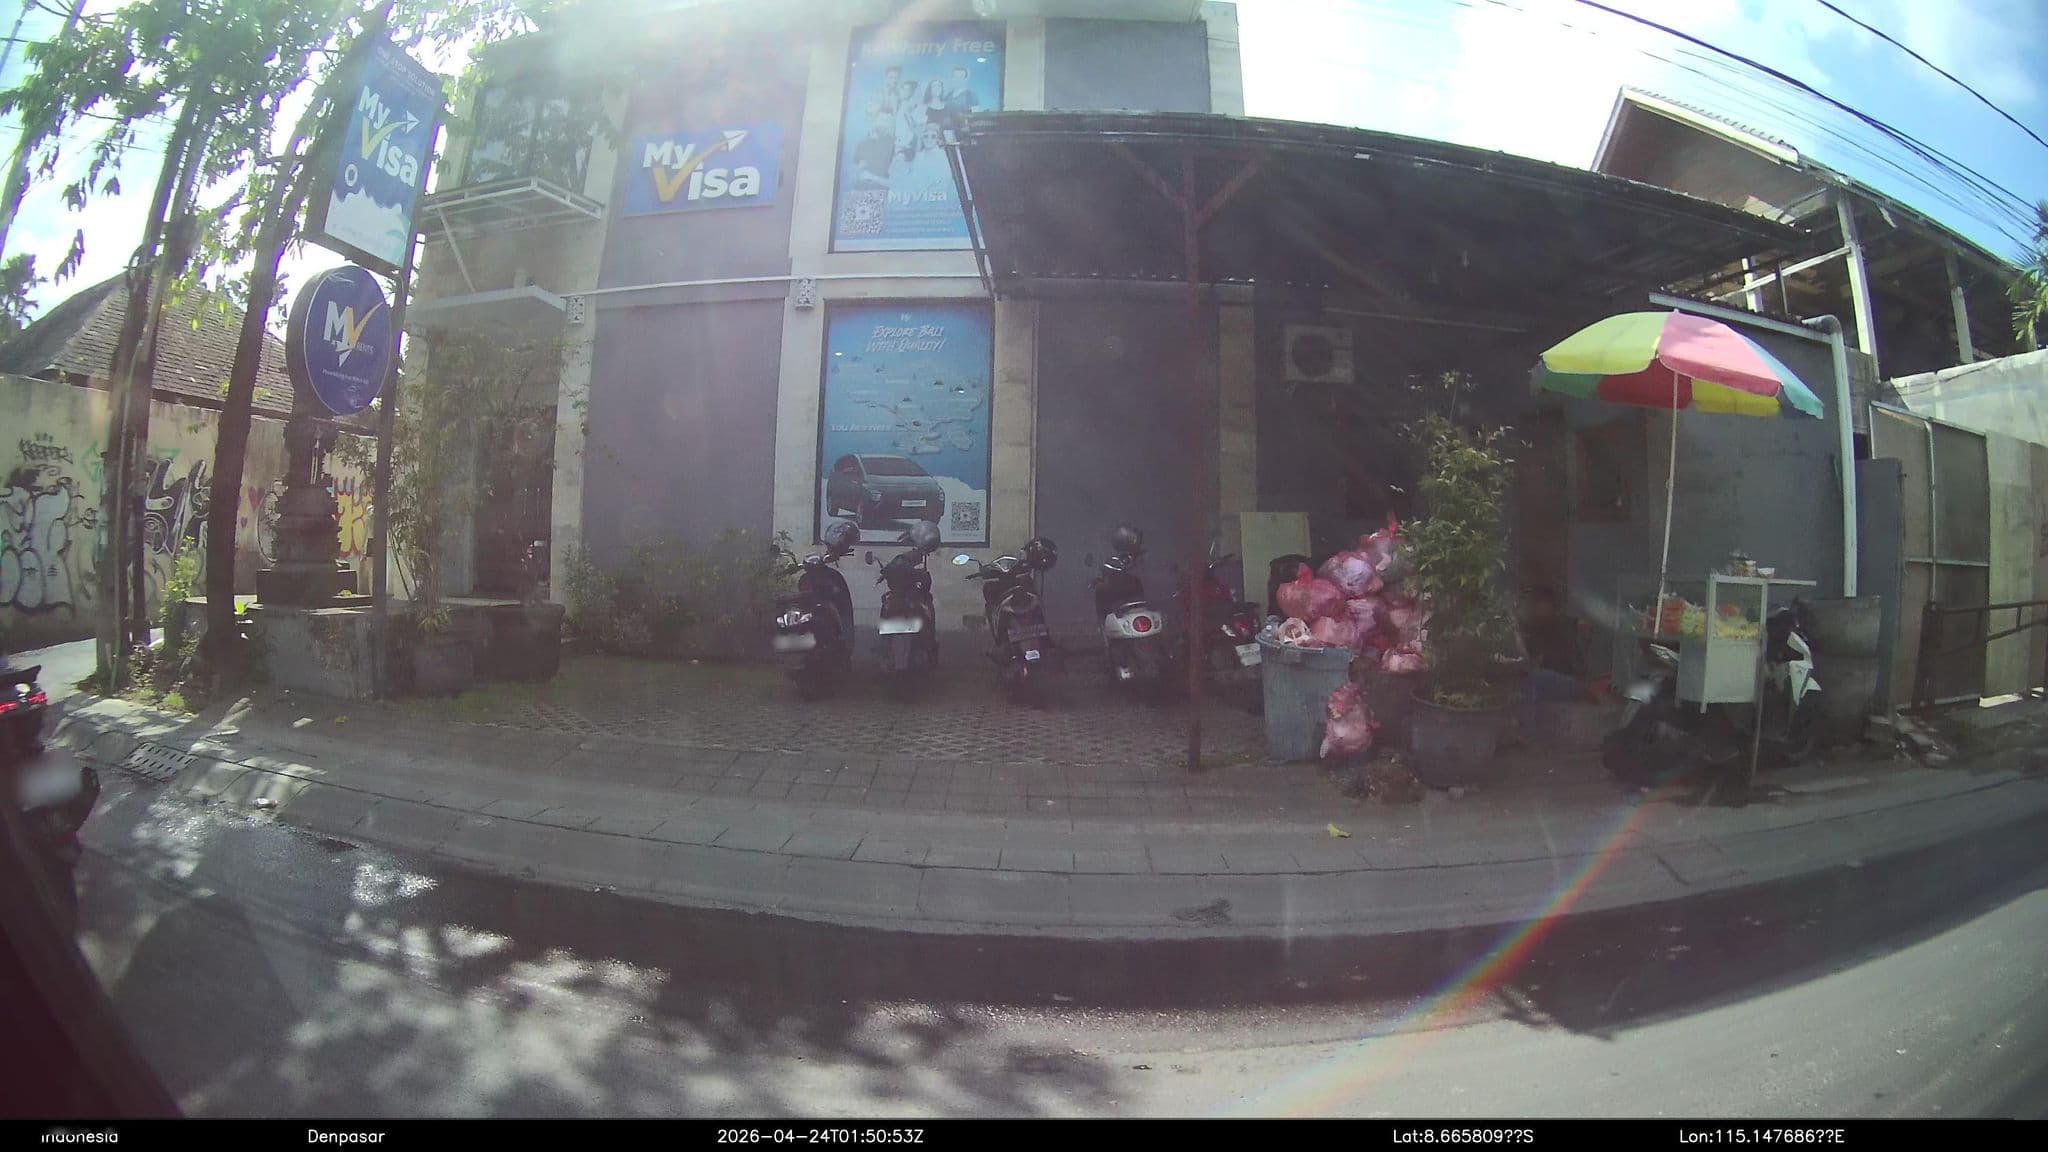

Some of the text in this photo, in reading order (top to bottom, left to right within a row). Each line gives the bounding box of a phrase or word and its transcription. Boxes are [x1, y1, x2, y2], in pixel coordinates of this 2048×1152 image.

[358, 85, 391, 130] My
[361, 115, 419, 188] Visa
[642, 140, 697, 170] My
[652, 151, 761, 203] Visa
